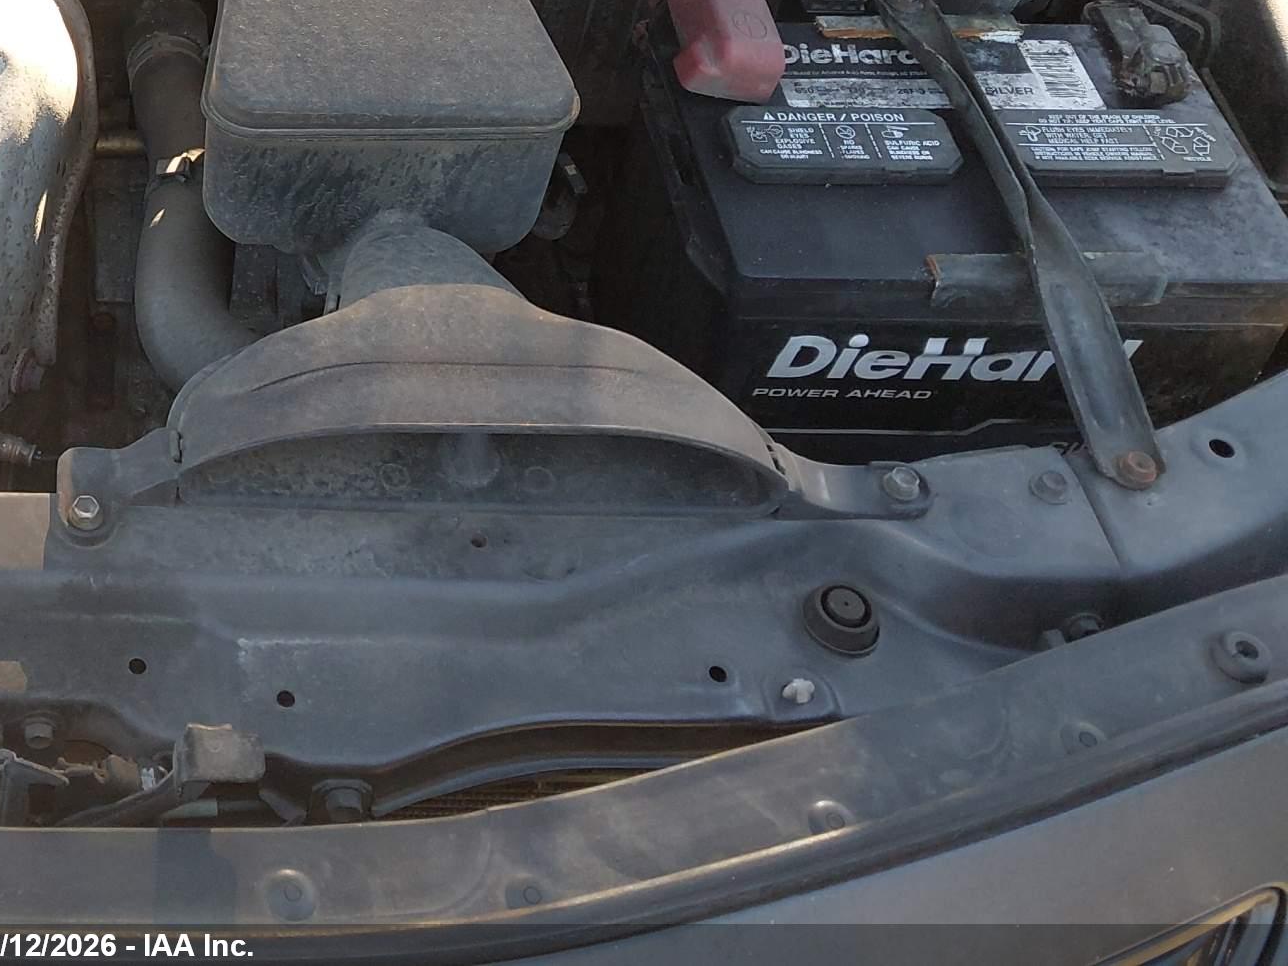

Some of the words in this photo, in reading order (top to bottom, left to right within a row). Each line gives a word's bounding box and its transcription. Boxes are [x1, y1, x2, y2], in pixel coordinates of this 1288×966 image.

[984, 87, 1034, 96] SILVER
[777, 113, 837, 122] DANGER
[852, 113, 905, 122] POISON
[752, 388, 838, 398] POWER
[844, 388, 933, 400] AHEAD
